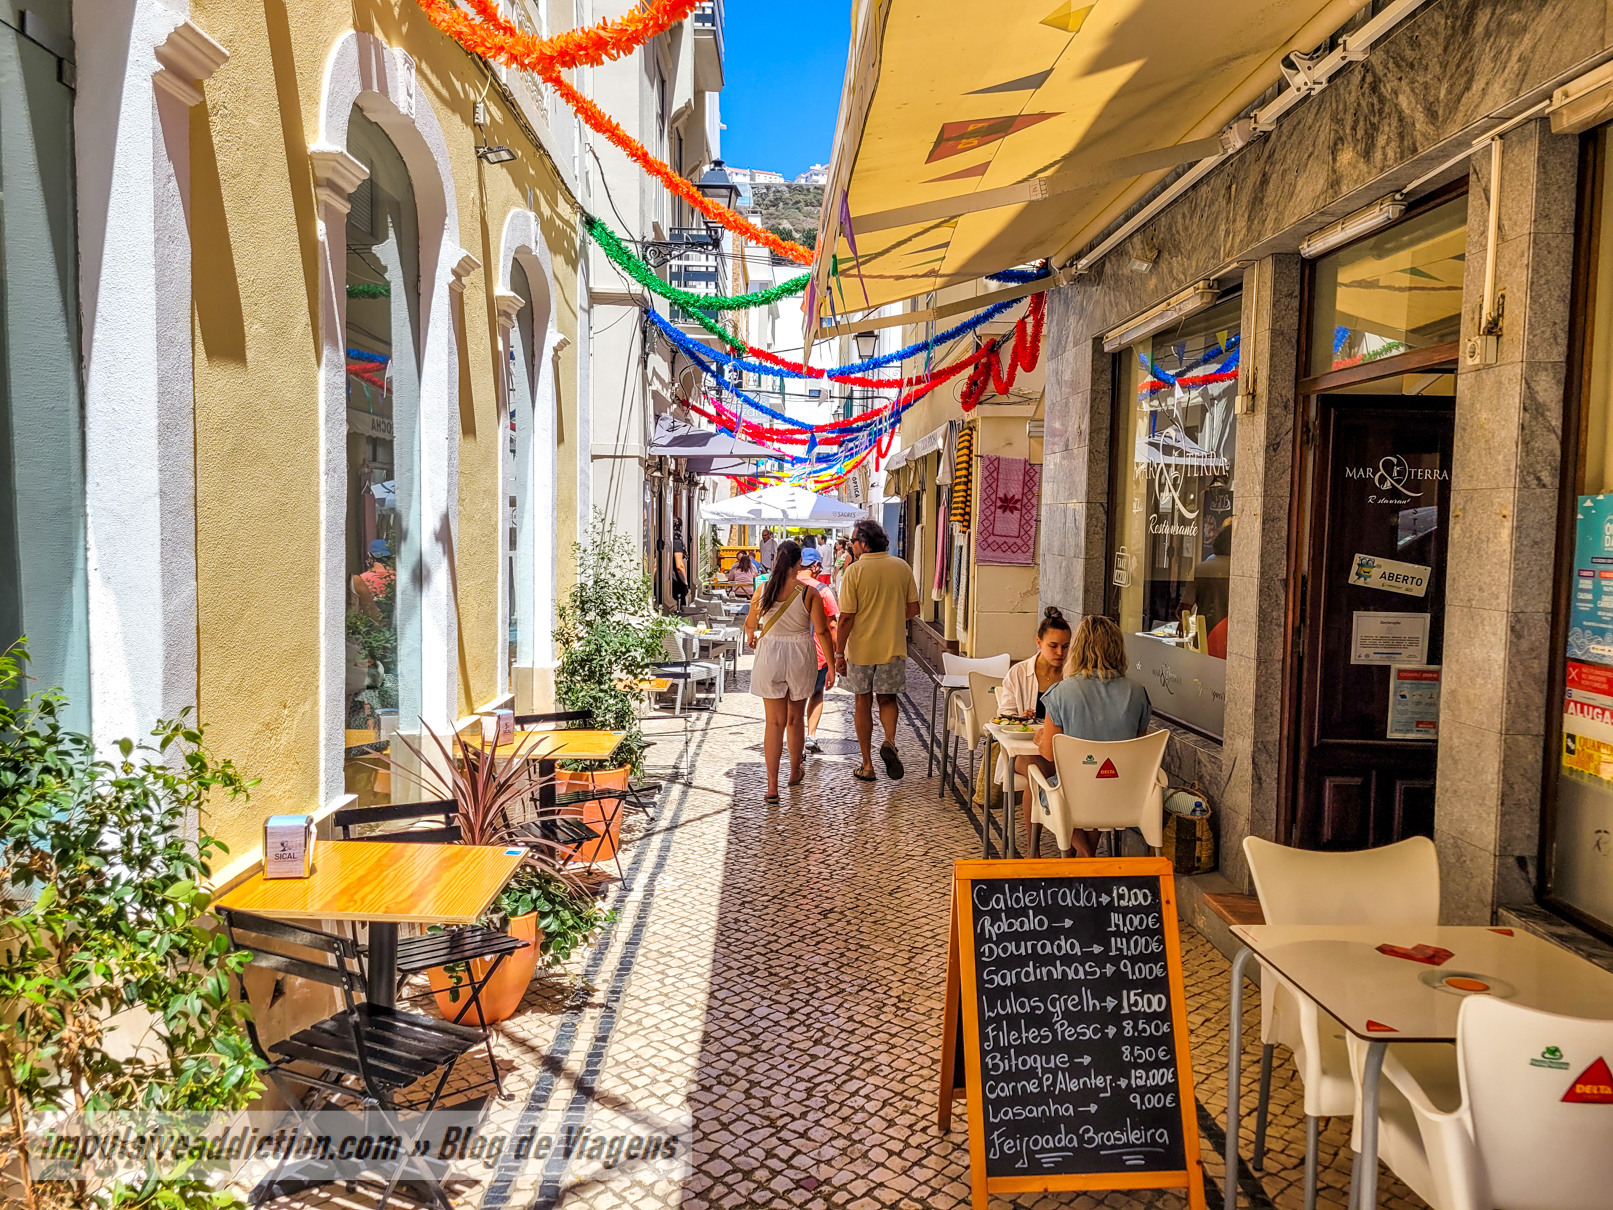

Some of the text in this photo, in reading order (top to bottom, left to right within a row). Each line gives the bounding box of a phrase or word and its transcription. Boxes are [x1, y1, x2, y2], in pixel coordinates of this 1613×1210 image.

[1345, 466, 1374, 480] MAR
[1409, 468, 1449, 480] TERRA
[1379, 571, 1423, 587] ABERTO
[274, 853, 298, 861] SICAL
[974, 882, 1097, 910] Caldeirada
[977, 910, 1048, 941] Robalo
[980, 935, 1081, 962] Dourada
[983, 961, 1100, 989] Sardinhas
[983, 992, 1044, 1020] Lulas
[984, 1019, 1052, 1050] Filetes
[1054, 1019, 1101, 1042] Pesc
[985, 1048, 1070, 1078] Bitoque
[1575, 1084, 1613, 1094] DELTA
[989, 1098, 1075, 1123] Lasanha
[989, 1118, 1169, 1168] Feijoada Brasileira
